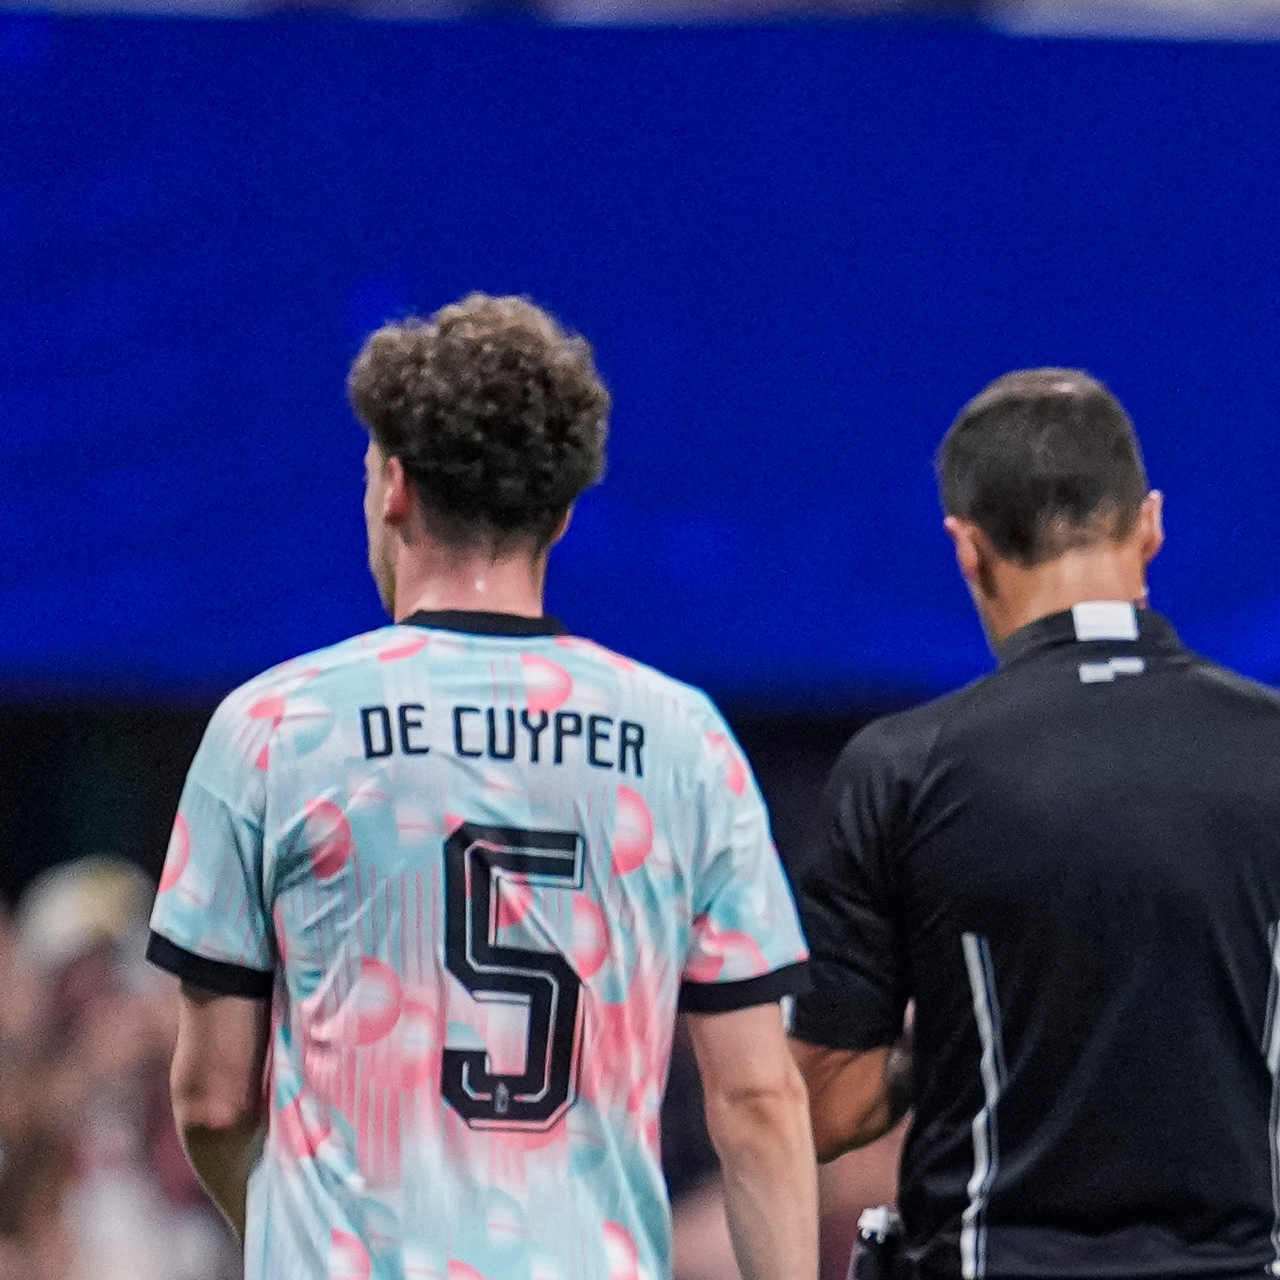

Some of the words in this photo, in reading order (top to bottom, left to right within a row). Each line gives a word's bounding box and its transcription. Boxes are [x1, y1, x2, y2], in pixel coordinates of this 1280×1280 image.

[360, 702, 430, 760] DE
[452, 705, 645, 777] CUYPER
[441, 822, 585, 1133] 5
